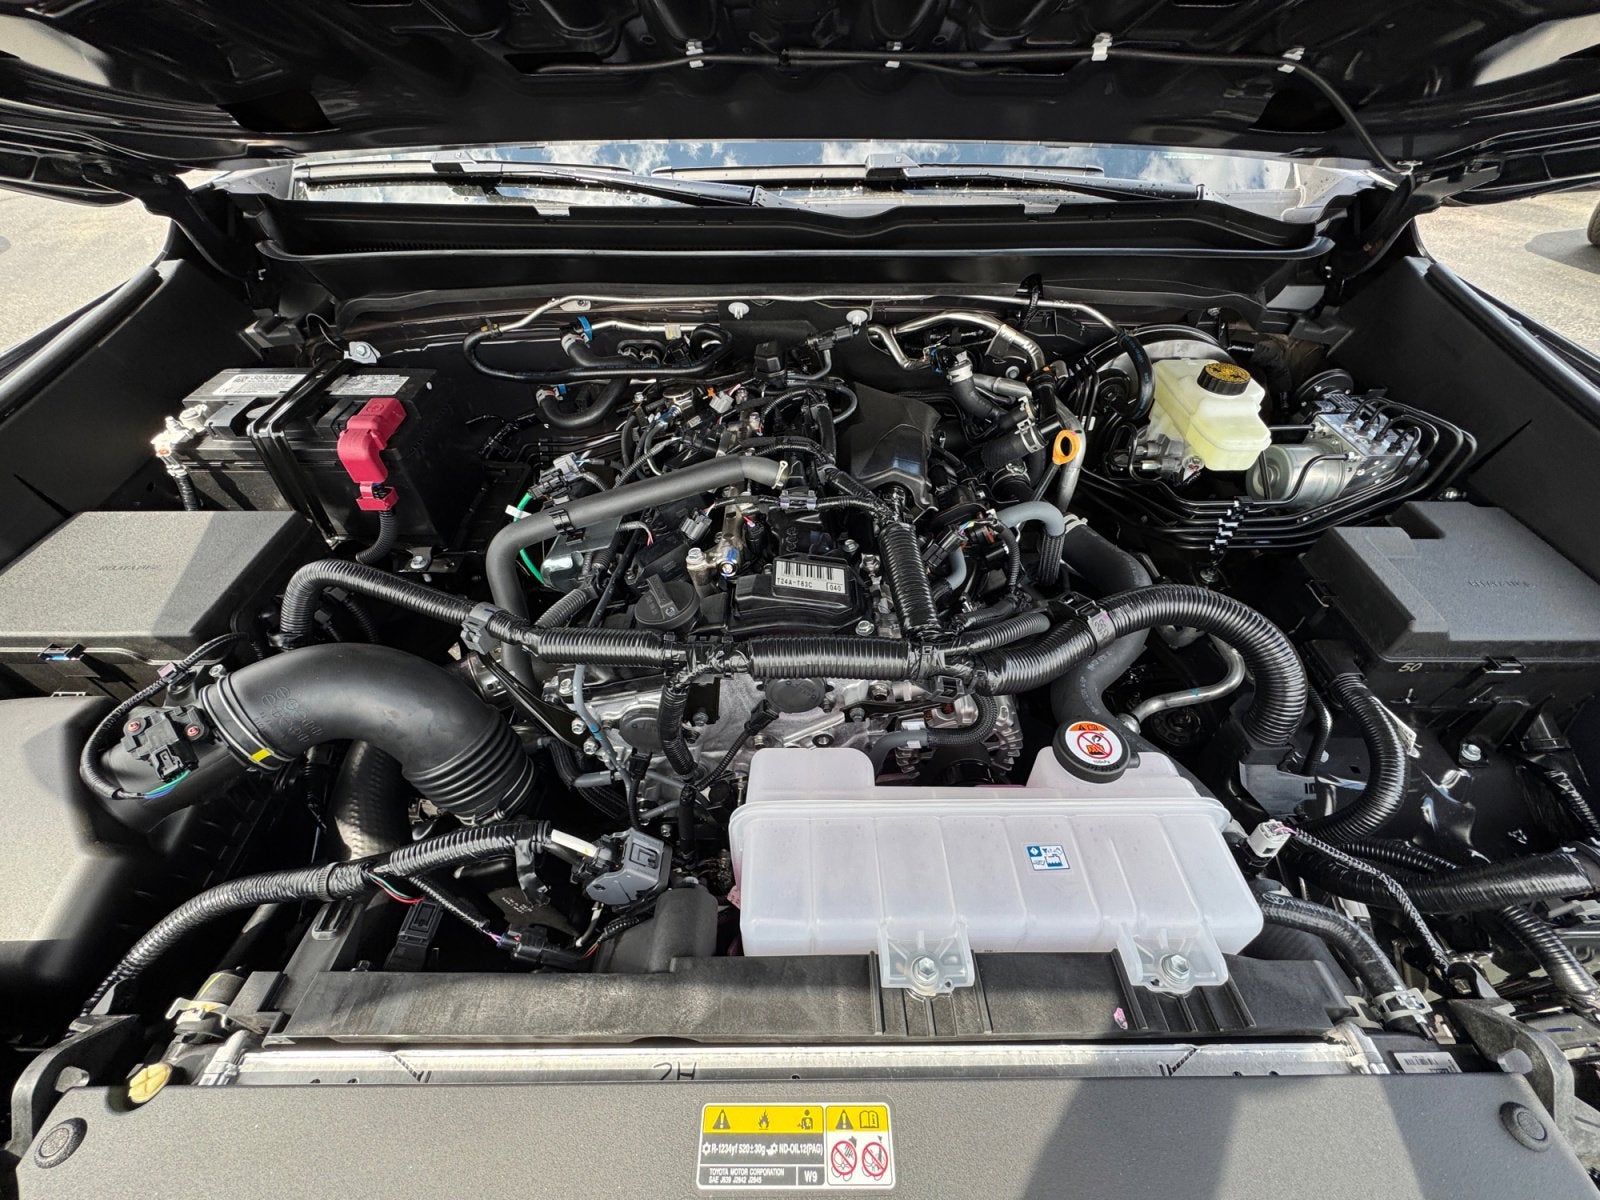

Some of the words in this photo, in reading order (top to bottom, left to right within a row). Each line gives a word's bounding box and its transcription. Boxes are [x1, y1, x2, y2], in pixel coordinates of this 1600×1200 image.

[1398, 662, 1423, 673] 50
[711, 1143, 738, 1156] R-1234yf
[738, 1143, 766, 1156] 520±30g
[750, 1168, 784, 1176] CORPORATION
[804, 1170, 817, 1183] W9
